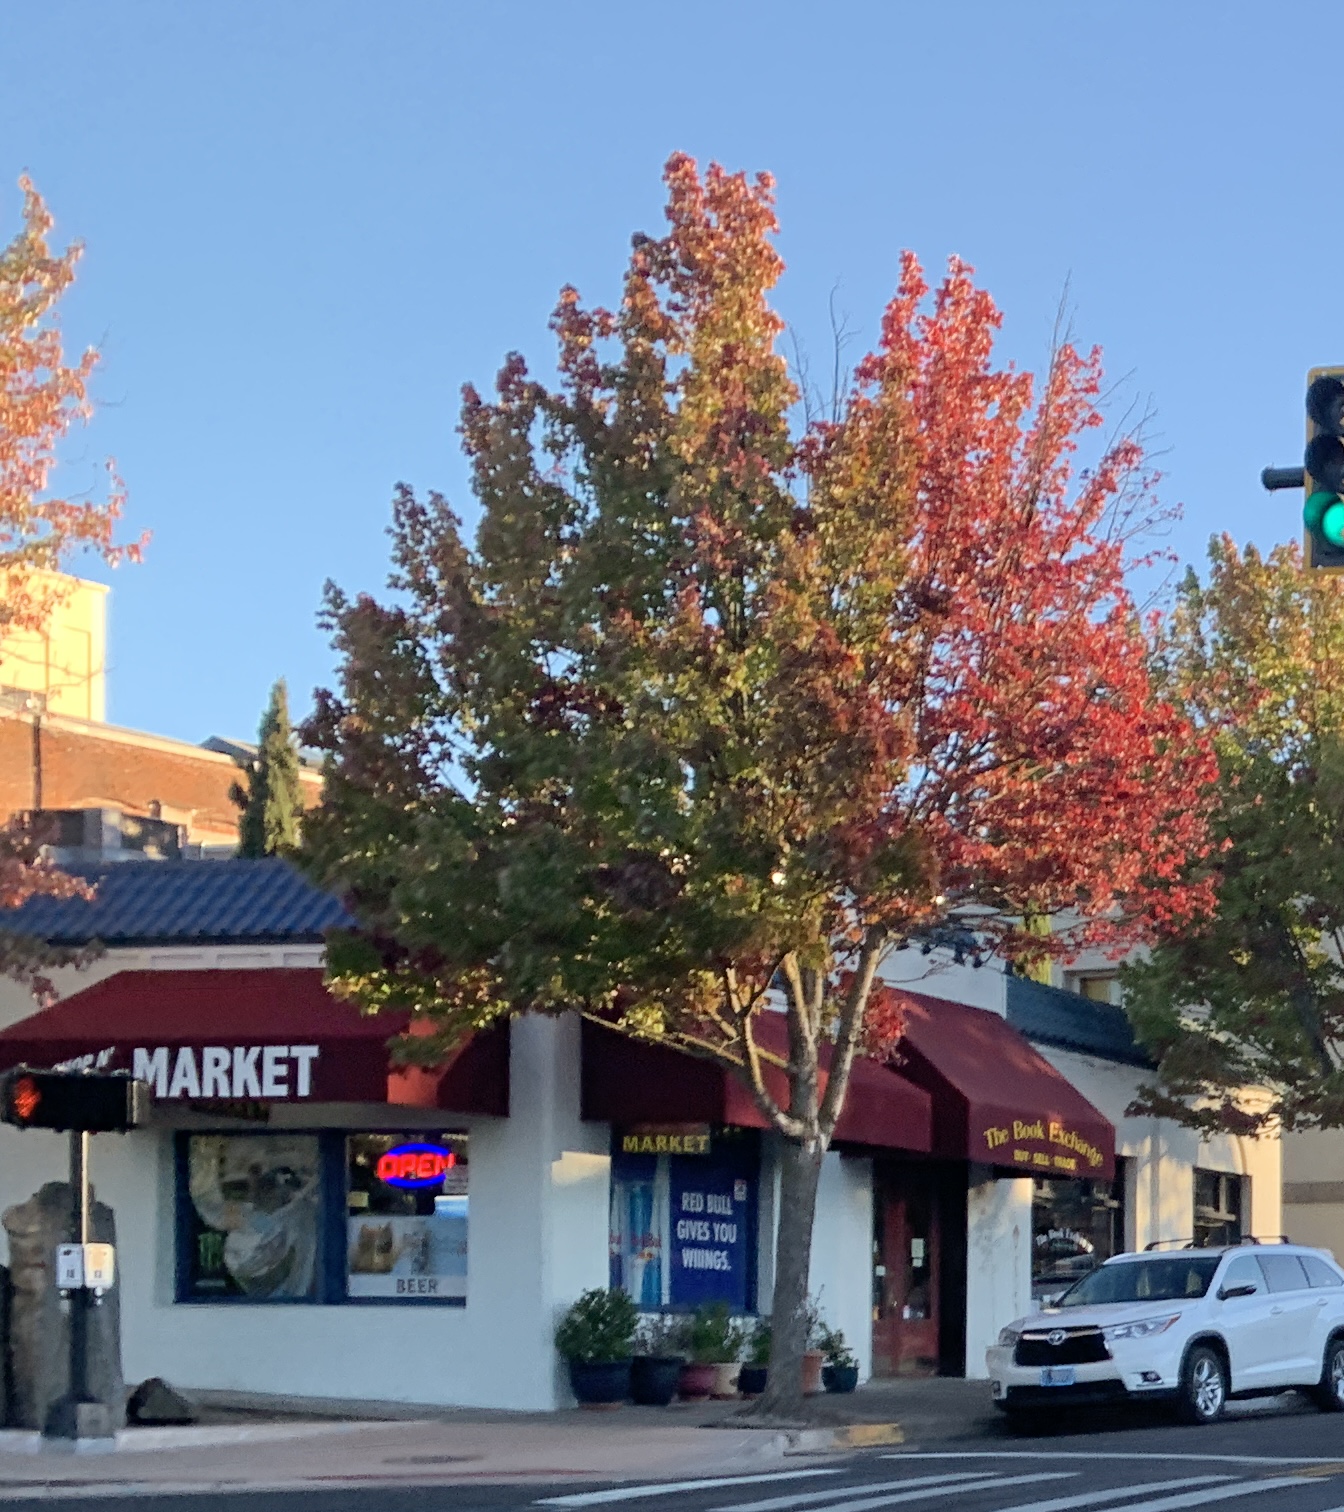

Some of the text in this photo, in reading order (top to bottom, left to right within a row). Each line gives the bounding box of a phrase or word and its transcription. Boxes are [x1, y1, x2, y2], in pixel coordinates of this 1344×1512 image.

[132, 1045, 319, 1098] MARKET
[622, 1134, 710, 1154] MARKET
[984, 1120, 1104, 1168] The Book Exchange
[376, 1152, 456, 1181] OPEN
[681, 1191, 734, 1215] RED BULL
[676, 1219, 738, 1244] GIVES YOU
[395, 1278, 439, 1294] BEER
